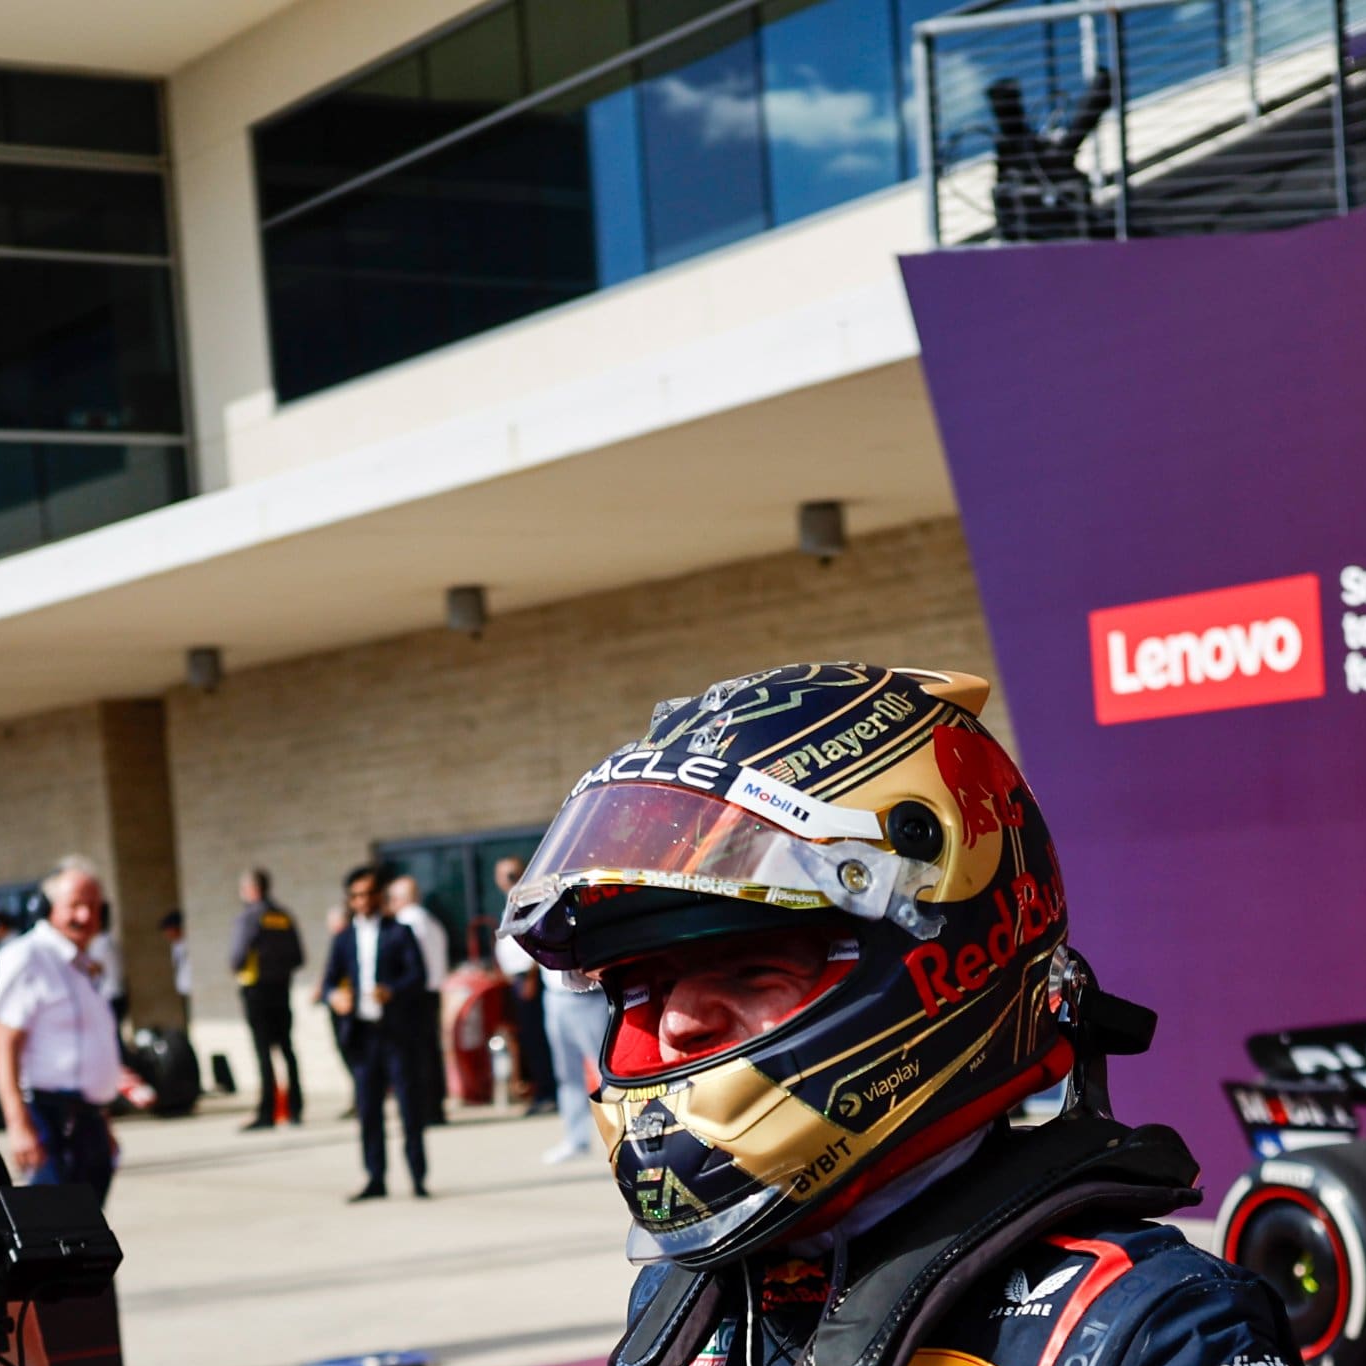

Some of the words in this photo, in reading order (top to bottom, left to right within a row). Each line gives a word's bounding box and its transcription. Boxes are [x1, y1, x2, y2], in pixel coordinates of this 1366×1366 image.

[1107, 617, 1303, 694] Lenovo
[785, 708, 891, 782] Player
[743, 783, 792, 813] Mobil
[792, 805, 810, 823] 1
[863, 1059, 920, 1103] viaplay
[969, 1052, 987, 1074] MAX
[791, 1137, 853, 1194] BYBIT
